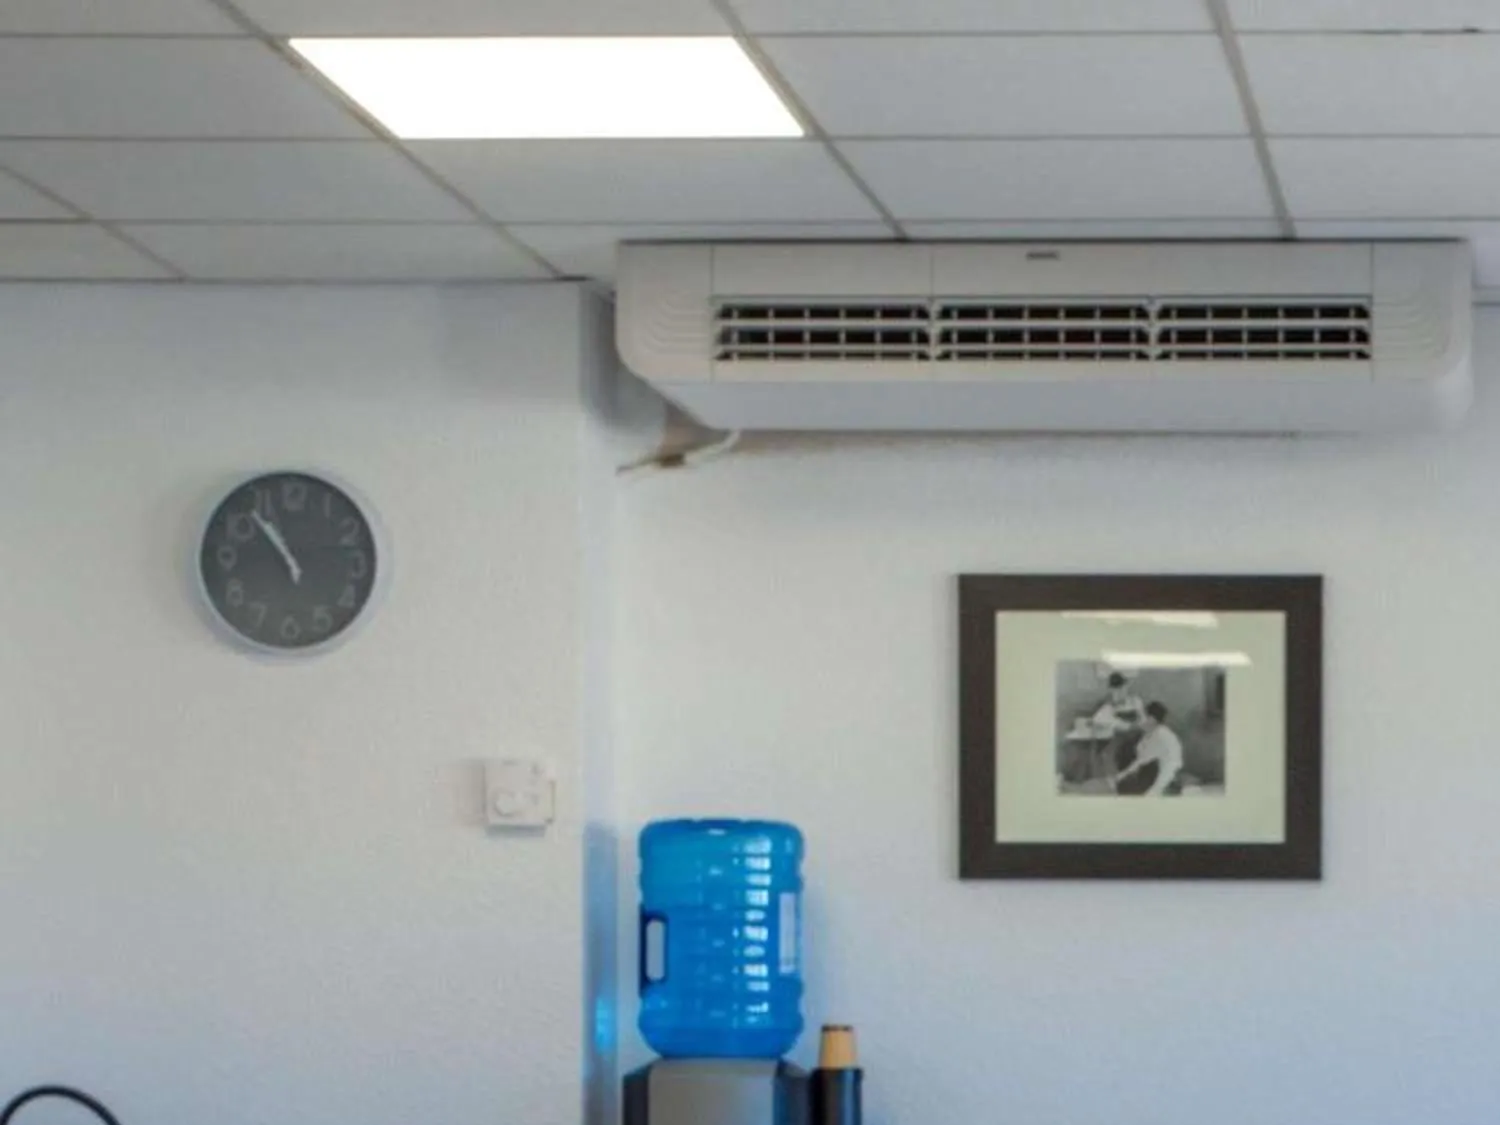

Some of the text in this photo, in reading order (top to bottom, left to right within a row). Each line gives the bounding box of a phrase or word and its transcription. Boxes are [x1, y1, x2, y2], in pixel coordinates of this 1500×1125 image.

[338, 516, 360, 545] 2
[250, 602, 267, 628] 7
[280, 615, 300, 640] 6
[312, 604, 333, 633] 5
